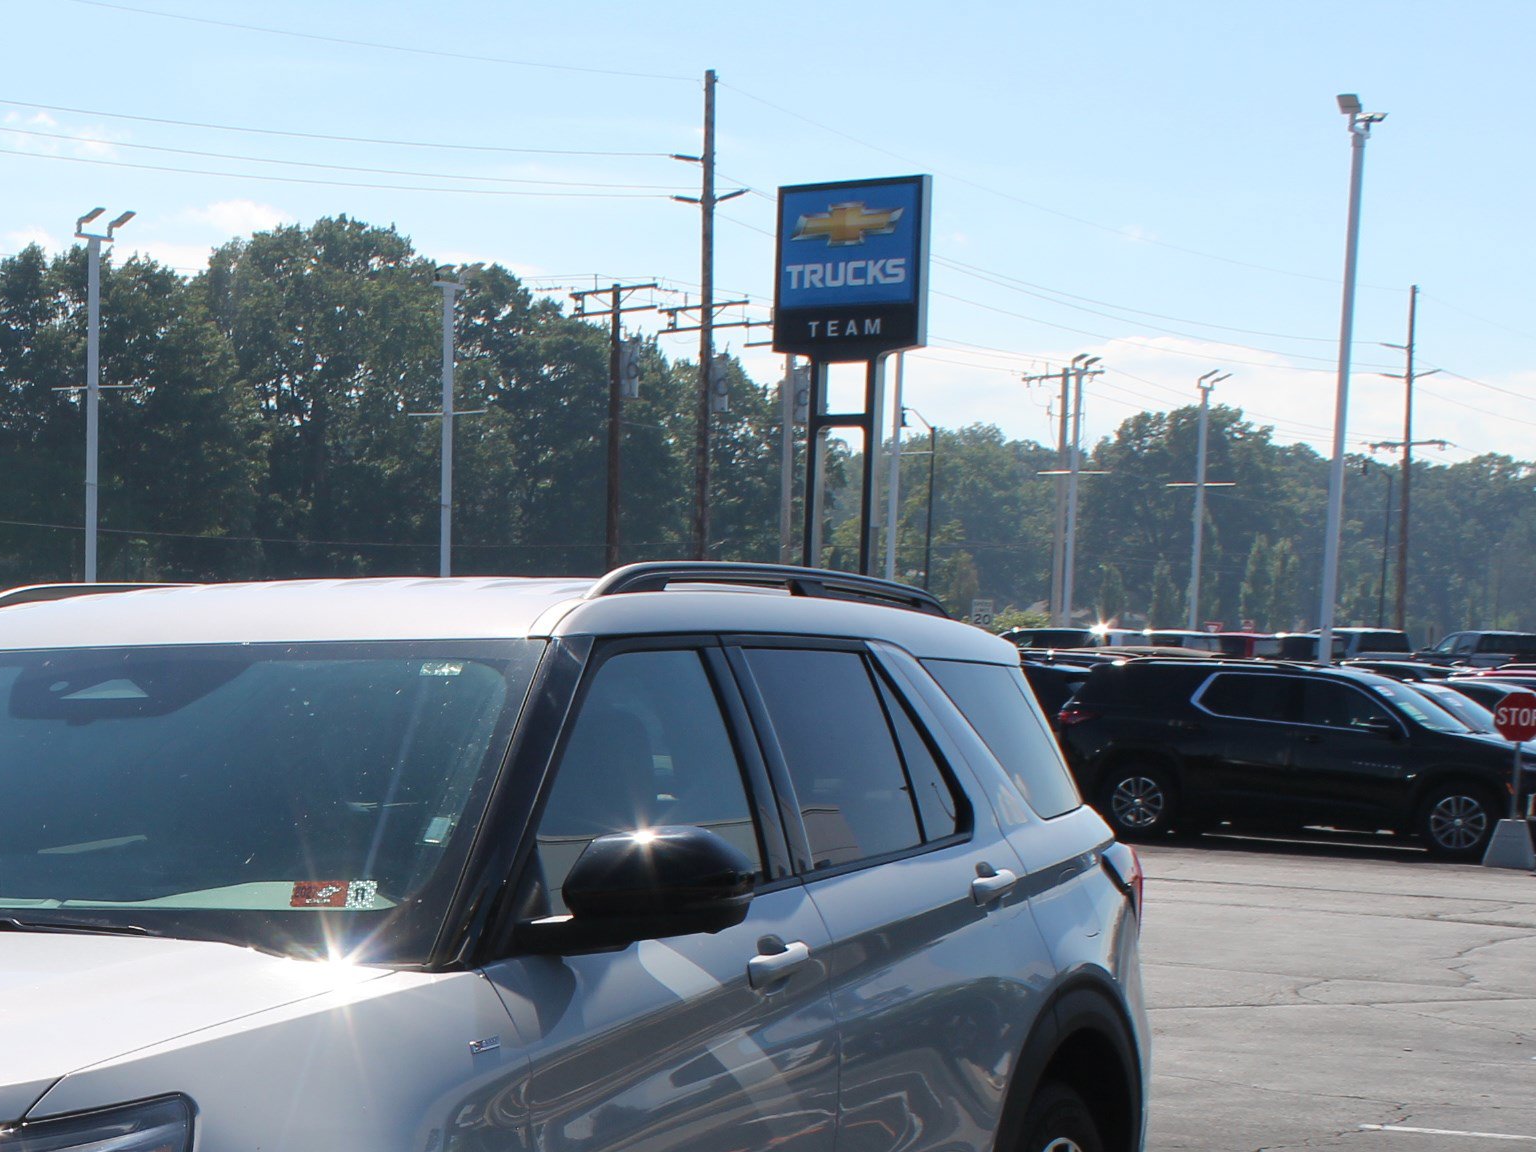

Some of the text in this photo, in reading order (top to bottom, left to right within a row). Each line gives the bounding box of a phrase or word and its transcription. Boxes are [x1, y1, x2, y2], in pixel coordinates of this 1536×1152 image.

[786, 258, 906, 289] TRUCKS
[808, 318, 882, 338] TEAM
[974, 613, 991, 625] 20
